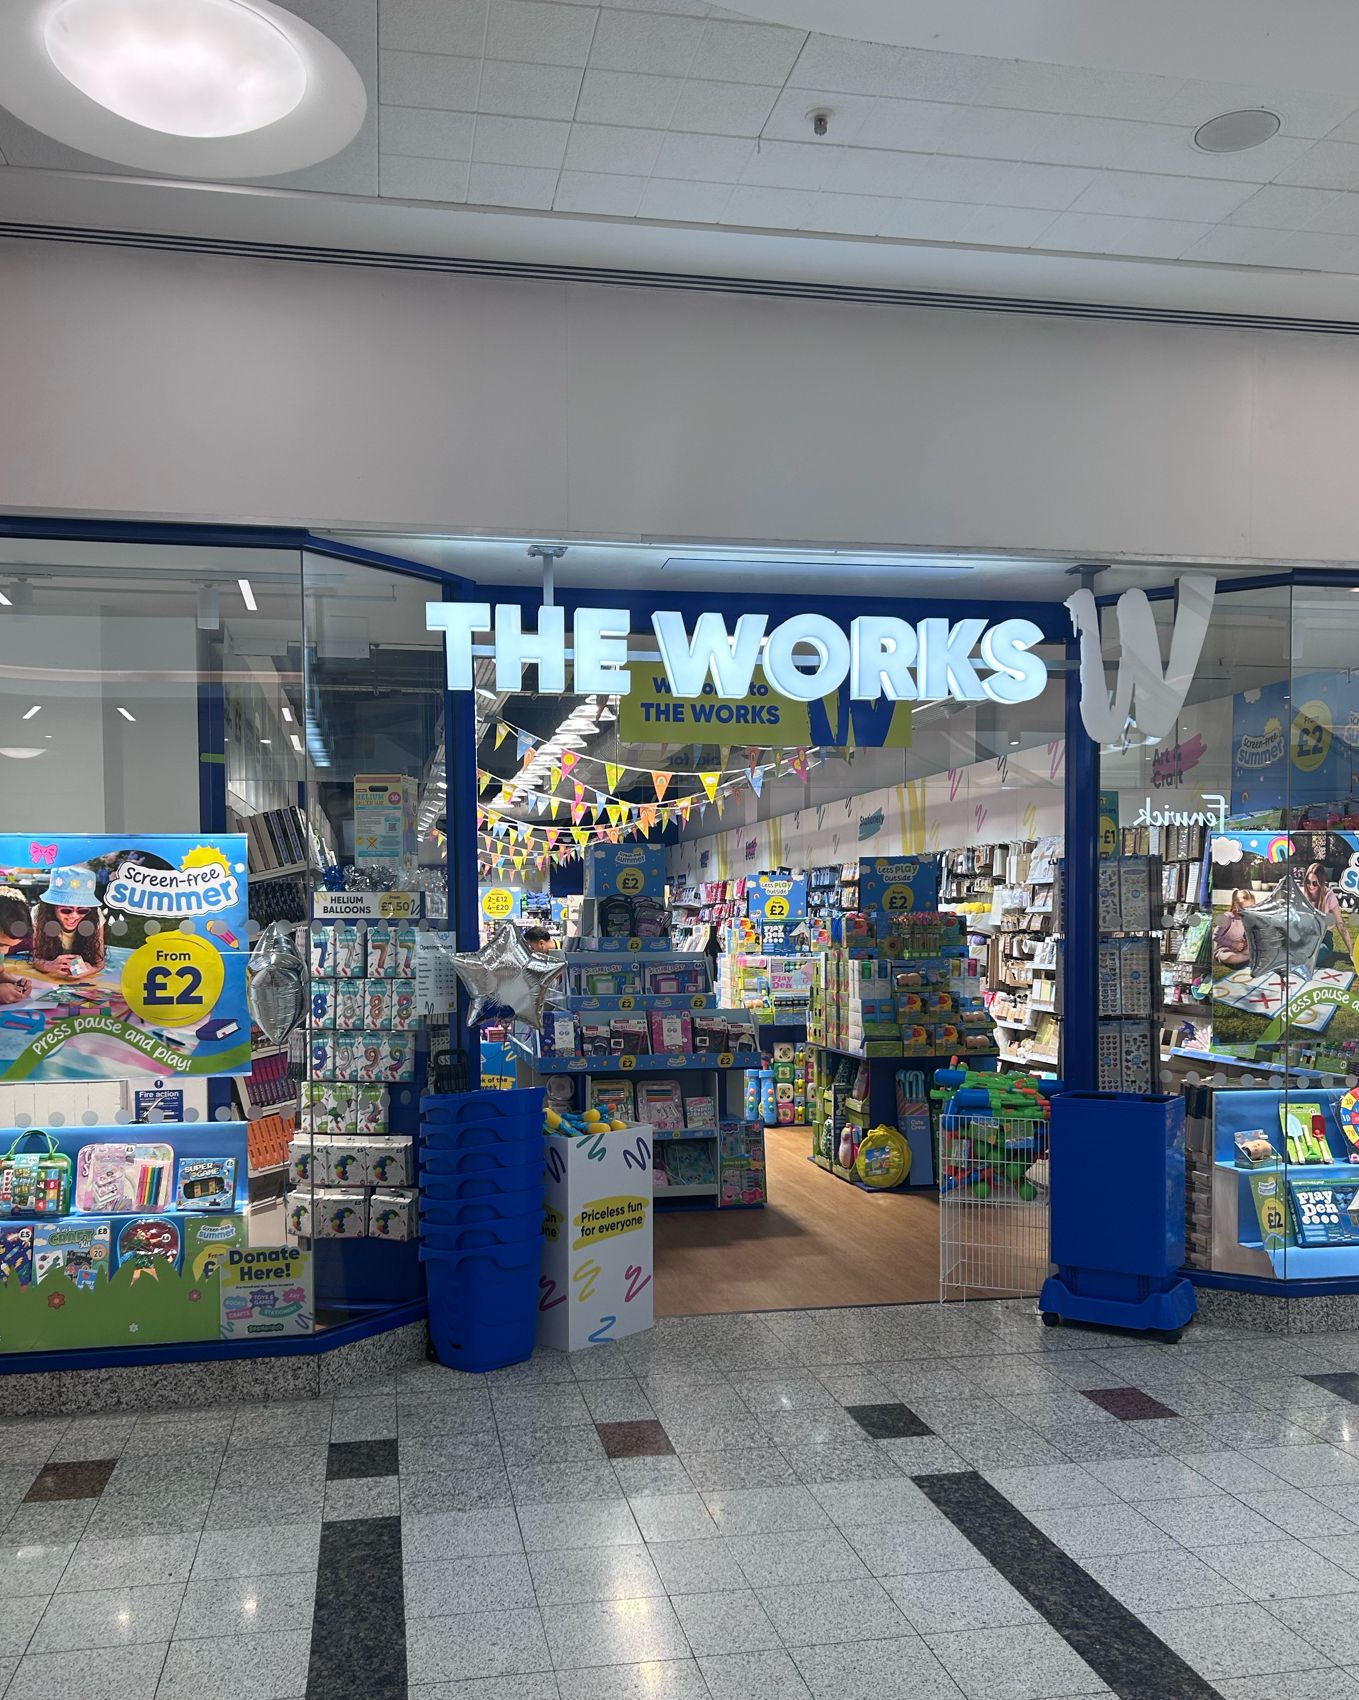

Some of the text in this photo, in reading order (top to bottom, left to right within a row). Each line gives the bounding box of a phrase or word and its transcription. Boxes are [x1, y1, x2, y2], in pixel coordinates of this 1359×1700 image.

[426, 602, 1048, 704] THE WORKS
[1063, 572, 1217, 746] W
[750, 681, 769, 697] to
[641, 703, 780, 724] THE WORKS
[1296, 725, 1324, 758] £2
[1152, 748, 1170, 767] Art
[124, 866, 220, 888] Screen-free
[622, 877, 639, 890] £2
[111, 880, 233, 912] summer
[330, 896, 364, 904] HELIUM
[888, 895, 908, 910] £2
[323, 906, 372, 914] BALLOONS
[769, 905, 785, 916] £2
[156, 950, 191, 962] From
[143, 966, 204, 1006] £2
[621, 1000, 632, 1008] £2
[693, 999, 703, 1007] £2
[1313, 989, 1350, 1004] pause
[74, 1017, 122, 1034] pause
[125, 1030, 152, 1052] and
[153, 1044, 192, 1071] play!
[622, 1060, 633, 1068] £2
[155, 1090, 179, 1098] action
[183, 1162, 214, 1173] SUPER
[196, 1169, 220, 1178] GAME
[1296, 1190, 1333, 1205] Play
[581, 1202, 643, 1223] Priceless fun
[1301, 1203, 1339, 1217] Den
[580, 1215, 643, 1237] for everyone
[1267, 1212, 1284, 1229] £2
[48, 1229, 94, 1246] CRAFT
[98, 1227, 108, 1235] £8
[198, 1228, 235, 1239] summer
[79, 1240, 92, 1249] Kit
[93, 1250, 103, 1258] 20
[229, 1247, 300, 1265] Donate
[240, 1263, 291, 1281] Here!
